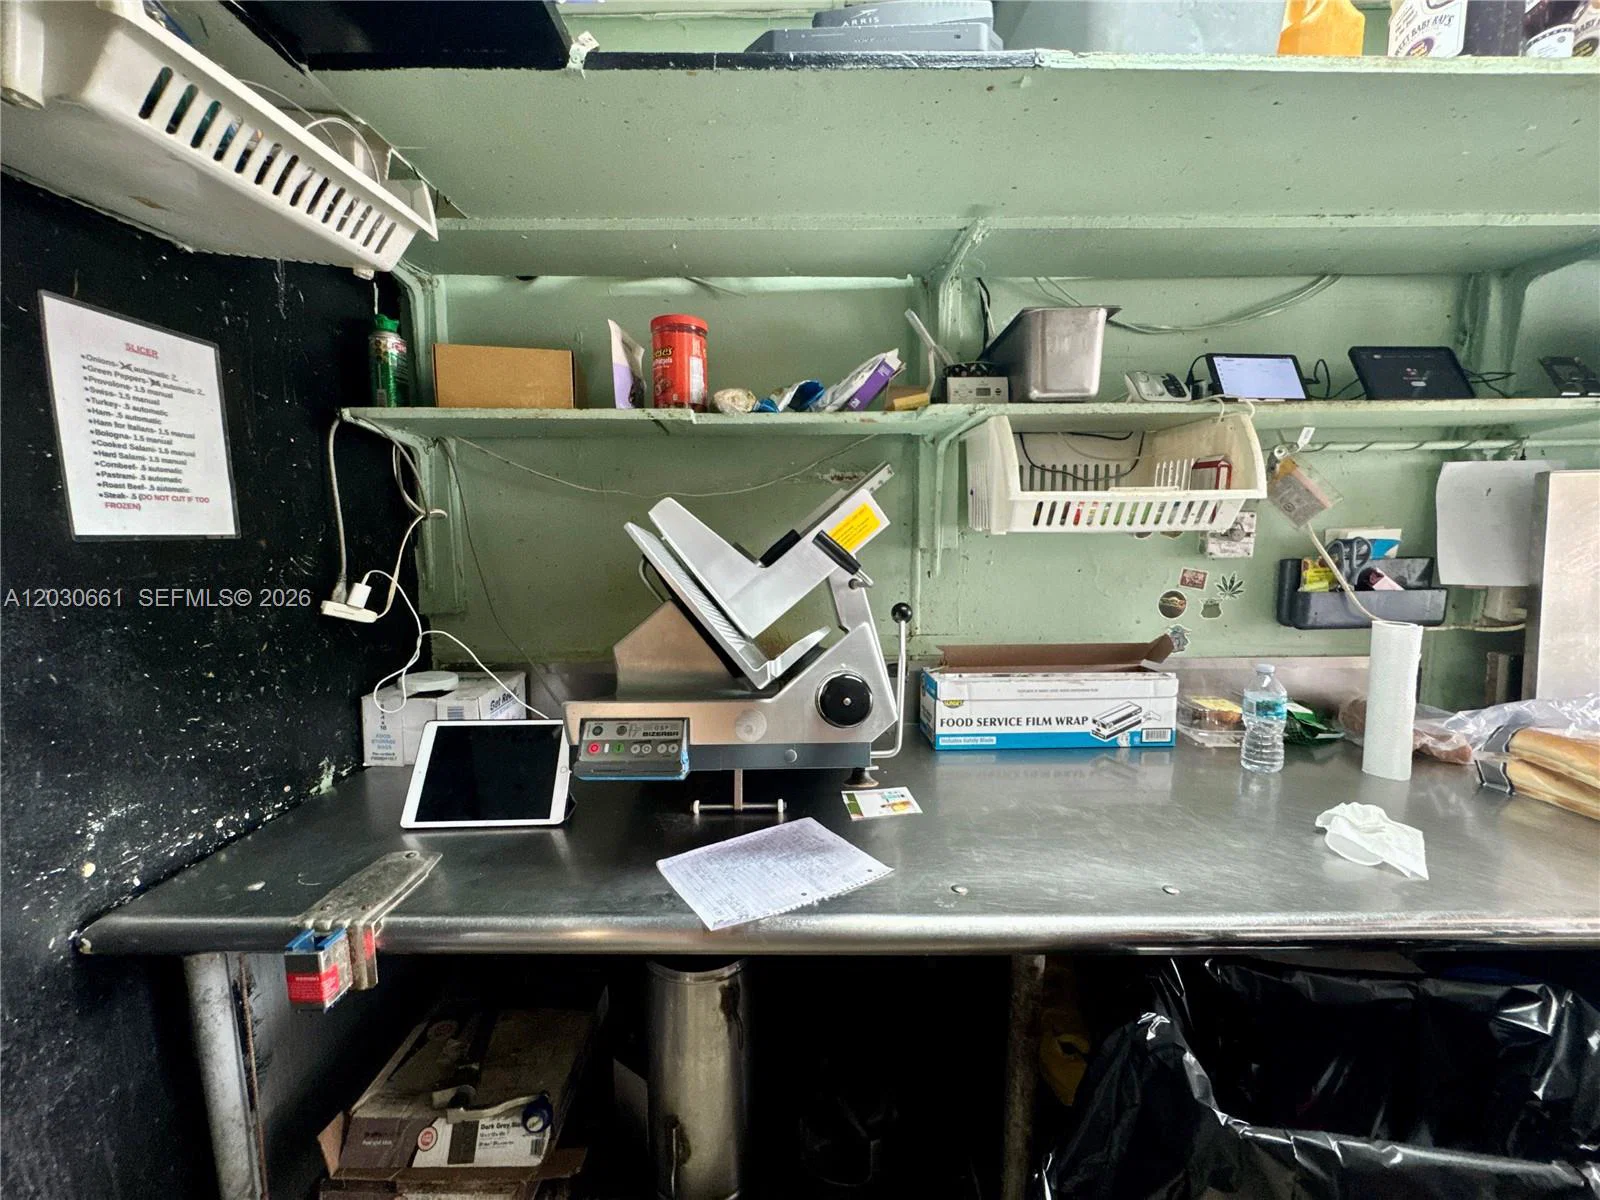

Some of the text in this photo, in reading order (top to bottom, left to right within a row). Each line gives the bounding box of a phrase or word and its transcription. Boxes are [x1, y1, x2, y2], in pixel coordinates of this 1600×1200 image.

[841, 17, 880, 27] ARRIS
[1411, 20, 1430, 37] BABY
[125, 343, 159, 359] SLICER
[86, 354, 119, 367] Onions-
[134, 367, 170, 379] automatic
[87, 365, 112, 376] Green
[163, 382, 195, 394] automatic
[132, 395, 160, 405] manual
[147, 389, 173, 399] manual
[132, 405, 168, 417] automatic
[125, 414, 161, 424] automatic
[93, 419, 112, 428] Ham
[114, 421, 125, 429] for
[171, 431, 195, 439] manual
[95, 429, 131, 440] Bologna-
[146, 437, 173, 445] manual
[96, 440, 127, 449] Cooked
[171, 449, 196, 457] manual
[98, 450, 116, 458] Hard
[148, 465, 183, 474] automatic
[101, 470, 137, 480] Pastrami-
[148, 475, 182, 483] automatic
[102, 481, 125, 489] Roast
[157, 485, 190, 493] automatic
[104, 501, 141, 510] FROZEN)
[940, 716, 1089, 727] FOOD SERVICE FILM WRAP
